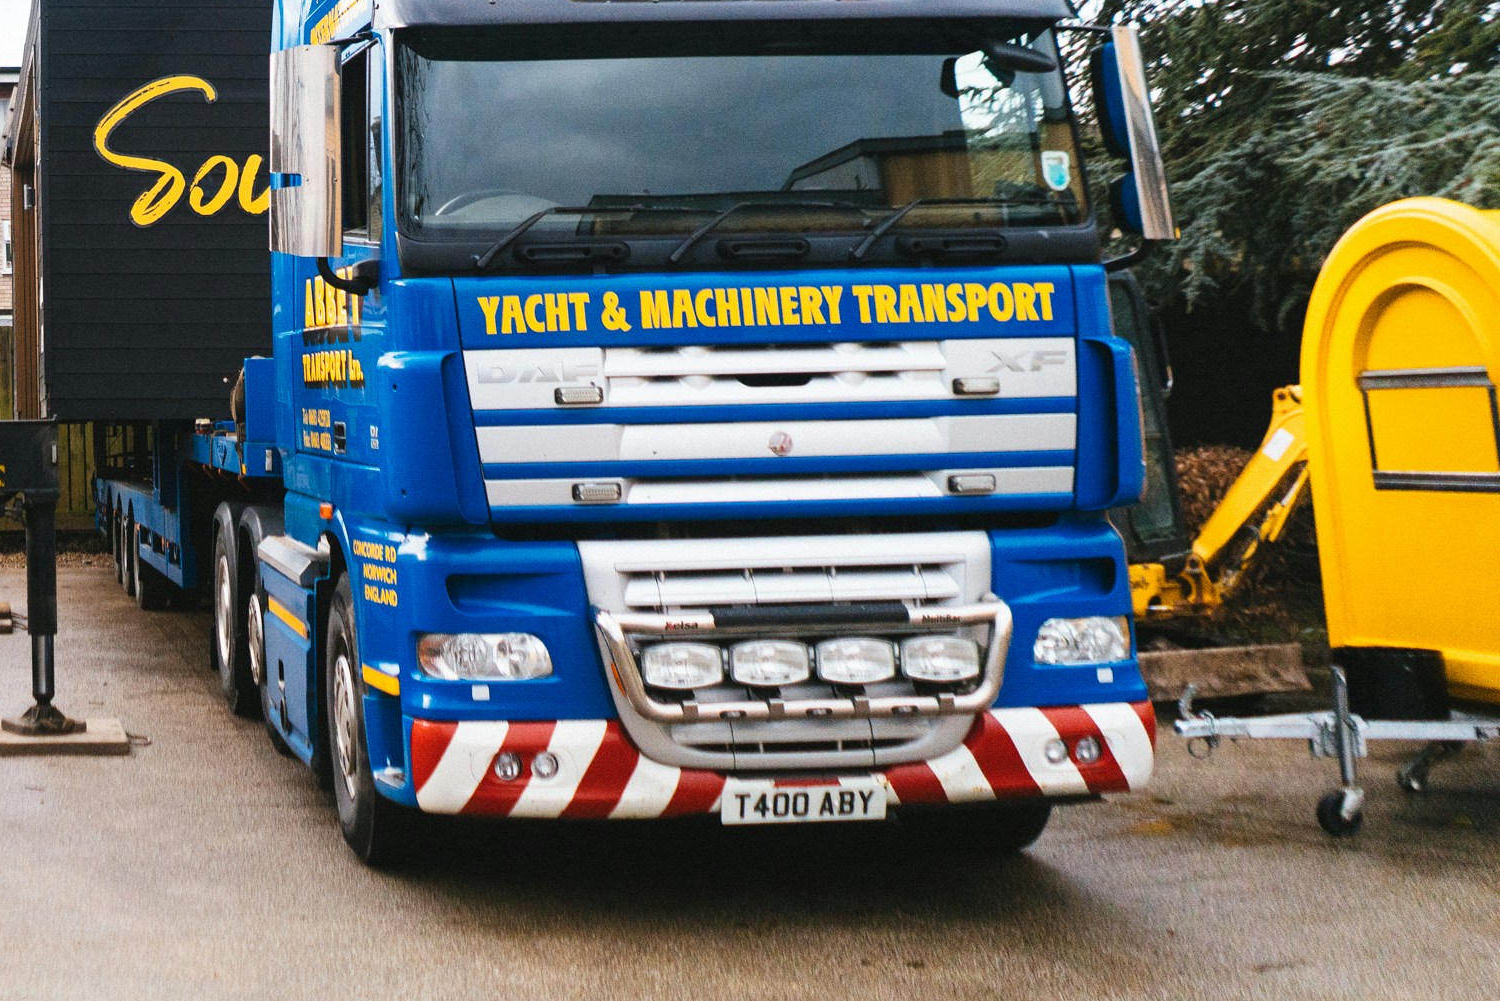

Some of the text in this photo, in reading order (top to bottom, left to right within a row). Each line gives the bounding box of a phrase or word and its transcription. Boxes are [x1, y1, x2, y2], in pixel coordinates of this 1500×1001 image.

[477, 282, 1055, 335] YACHT & MACHINERY TRANSPORT
[302, 350, 347, 383] TRANSPORT
[477, 360, 599, 385] DAF
[984, 350, 1068, 374] XF
[353, 539, 397, 563] CONCORDE RD
[363, 563, 398, 586] NORWICH
[364, 584, 398, 608] ENGLAND
[734, 790, 874, 819] T400 ABY
